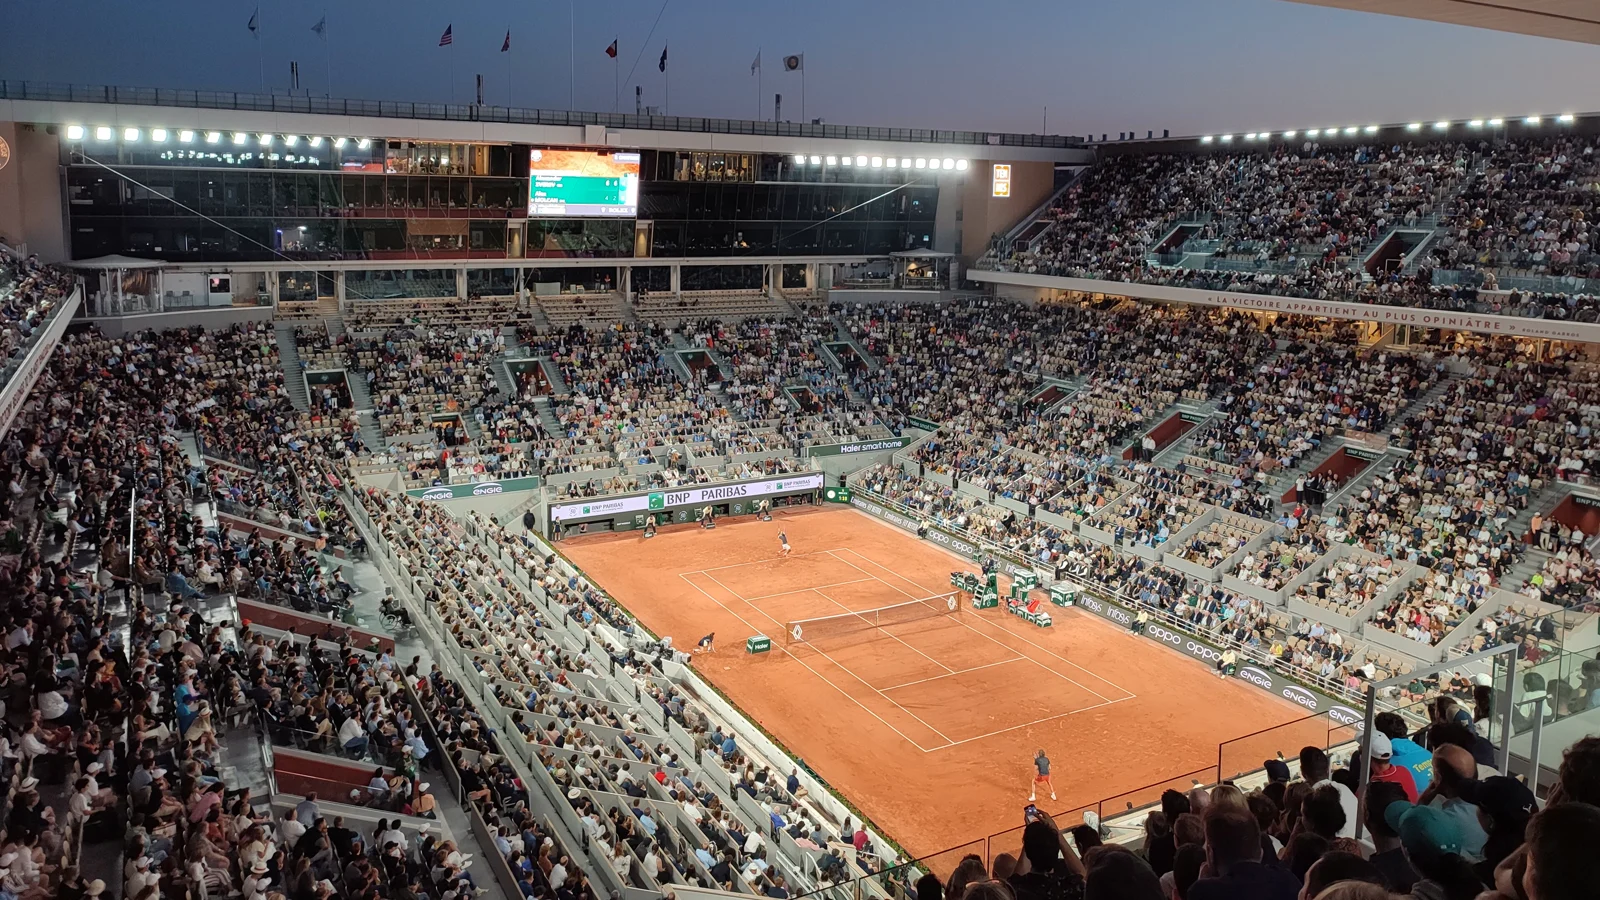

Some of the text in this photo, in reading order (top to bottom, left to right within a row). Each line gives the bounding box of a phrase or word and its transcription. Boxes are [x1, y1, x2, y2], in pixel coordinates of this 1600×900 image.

[1232, 298, 1281, 308] VICTOIRE
[1286, 303, 1357, 316] APPARTIENT
[1386, 313, 1415, 321] PLUS
[1423, 316, 1500, 330] OPINIÂTRE
[841, 445, 861, 453] Haier
[862, 442, 882, 450] smart
[667, 485, 747, 504] BNP PARIBAS
[928, 530, 950, 544] oppo
[952, 540, 973, 554] oppo
[1080, 595, 1102, 612] Infosys
[1107, 606, 1130, 624] Infosys
[1148, 625, 1181, 644] oppo
[1186, 642, 1220, 661] oppo
[1240, 670, 1272, 689] ENGIE
[1283, 689, 1317, 709] ENGIE
